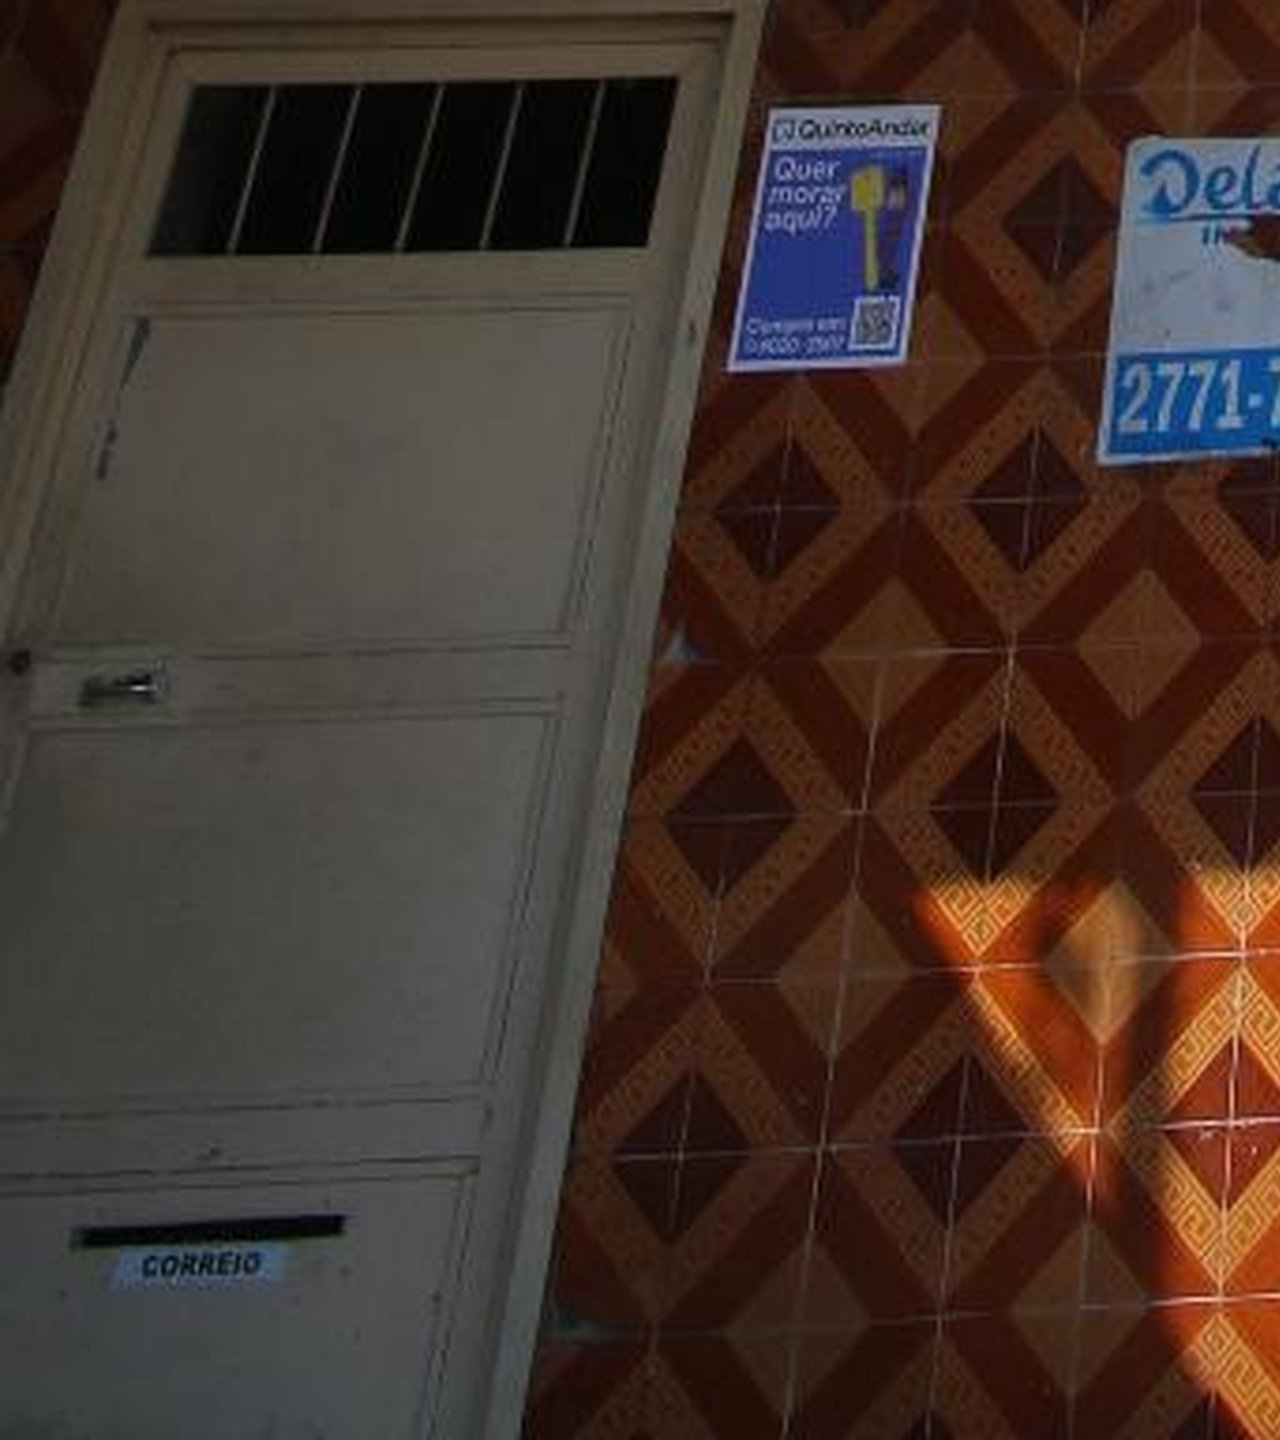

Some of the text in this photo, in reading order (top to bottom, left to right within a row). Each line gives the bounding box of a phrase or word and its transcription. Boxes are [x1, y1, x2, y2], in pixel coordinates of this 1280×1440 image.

[775, 157, 842, 181] Quer
[765, 205, 839, 235] aqui?
[142, 1251, 262, 1277] CORREIO
